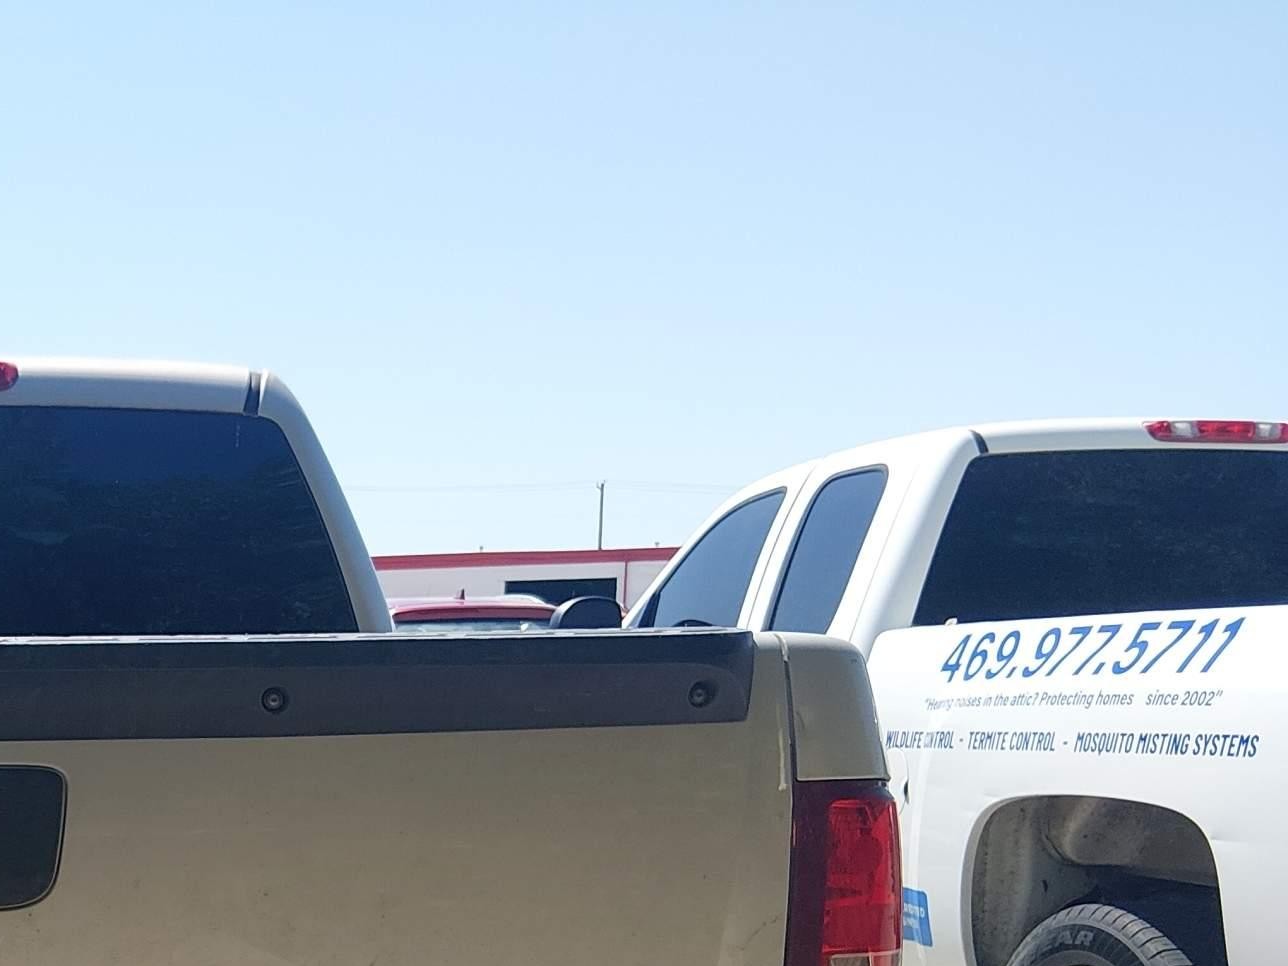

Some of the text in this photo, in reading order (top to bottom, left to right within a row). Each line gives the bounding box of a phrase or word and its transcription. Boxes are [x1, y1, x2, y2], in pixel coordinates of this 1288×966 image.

[940, 616, 1247, 684] 469.977.5711
[993, 693, 1010, 707] the
[1009, 690, 1040, 706] attic?
[1039, 689, 1095, 709] Protecting
[1095, 688, 1135, 706] homes
[1145, 689, 1179, 706] since
[1180, 690, 1223, 706] 2002"
[885, 730, 924, 750] WILDLIFE
[967, 731, 1009, 750] TERMITE
[1009, 731, 1056, 752] CONTROL
[1073, 732, 1135, 756] MOSQUITO
[1135, 733, 1191, 755] MISTING
[1192, 733, 1260, 758] SYSTEMS
